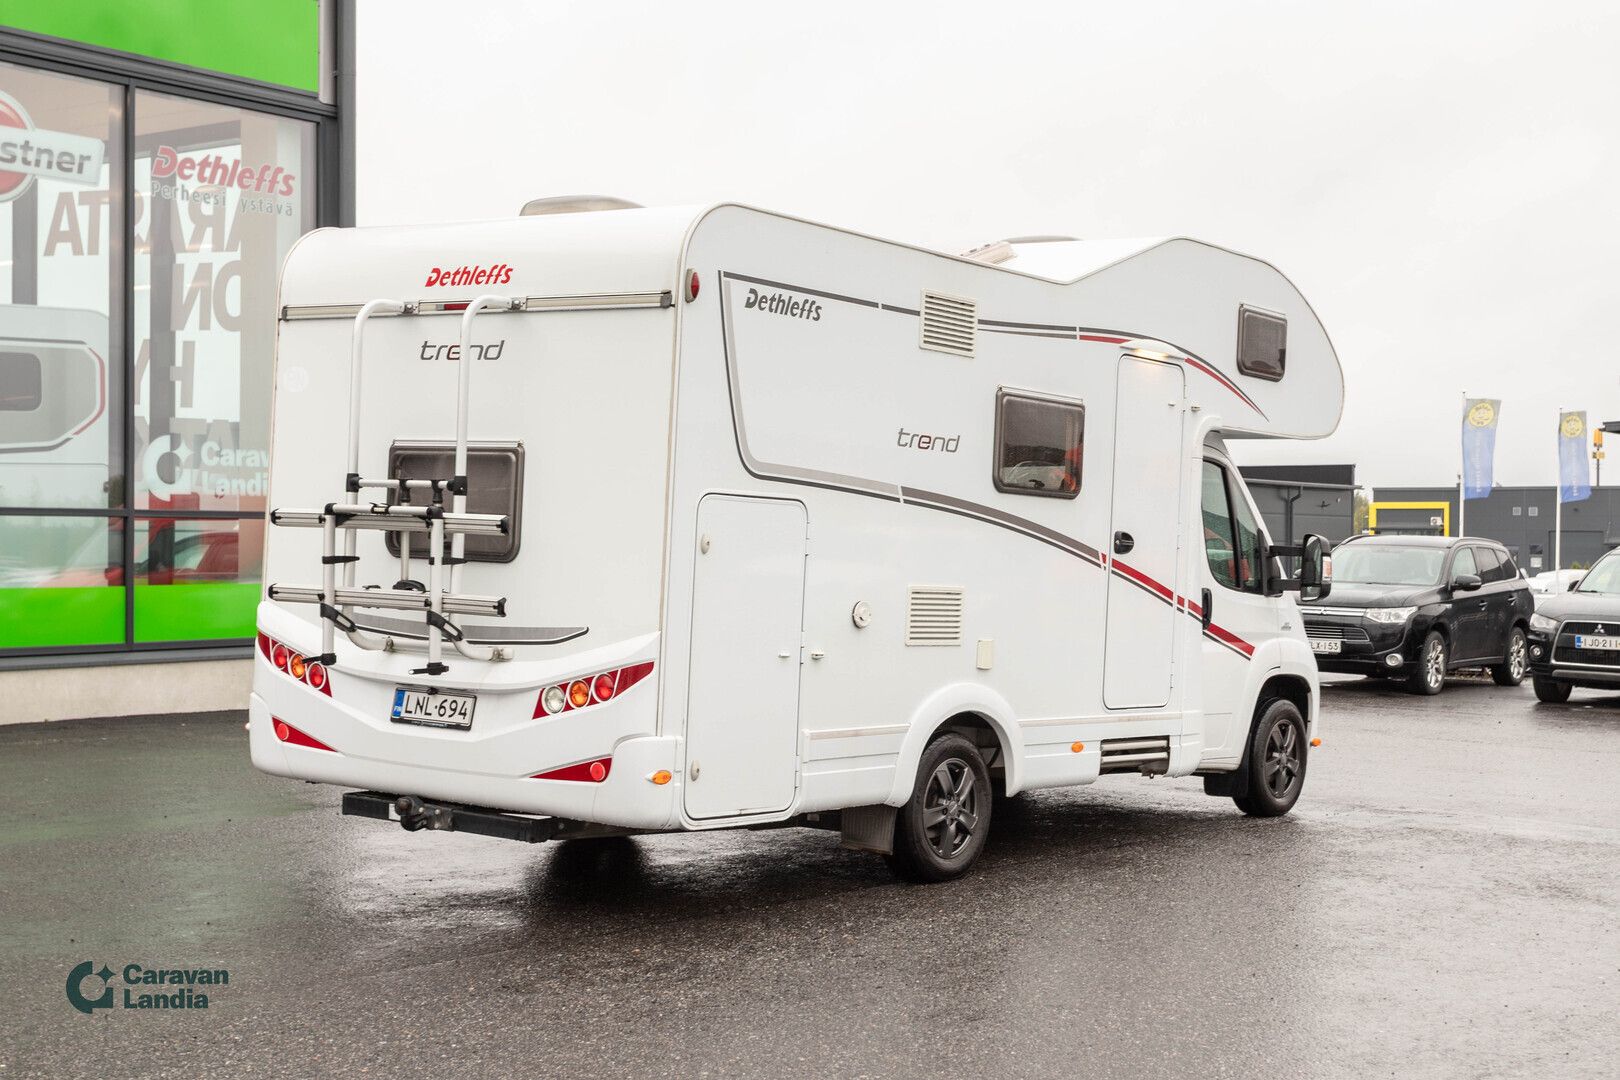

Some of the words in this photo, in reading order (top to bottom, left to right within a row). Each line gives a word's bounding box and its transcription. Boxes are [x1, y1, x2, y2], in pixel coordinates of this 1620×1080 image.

[152, 146, 296, 197] Dethleffs
[425, 264, 513, 287] Dethleffs
[744, 288, 822, 321] Dethleffs
[420, 340, 505, 361] trend
[897, 428, 961, 453] trend
[404, 694, 468, 720] LNL-694
